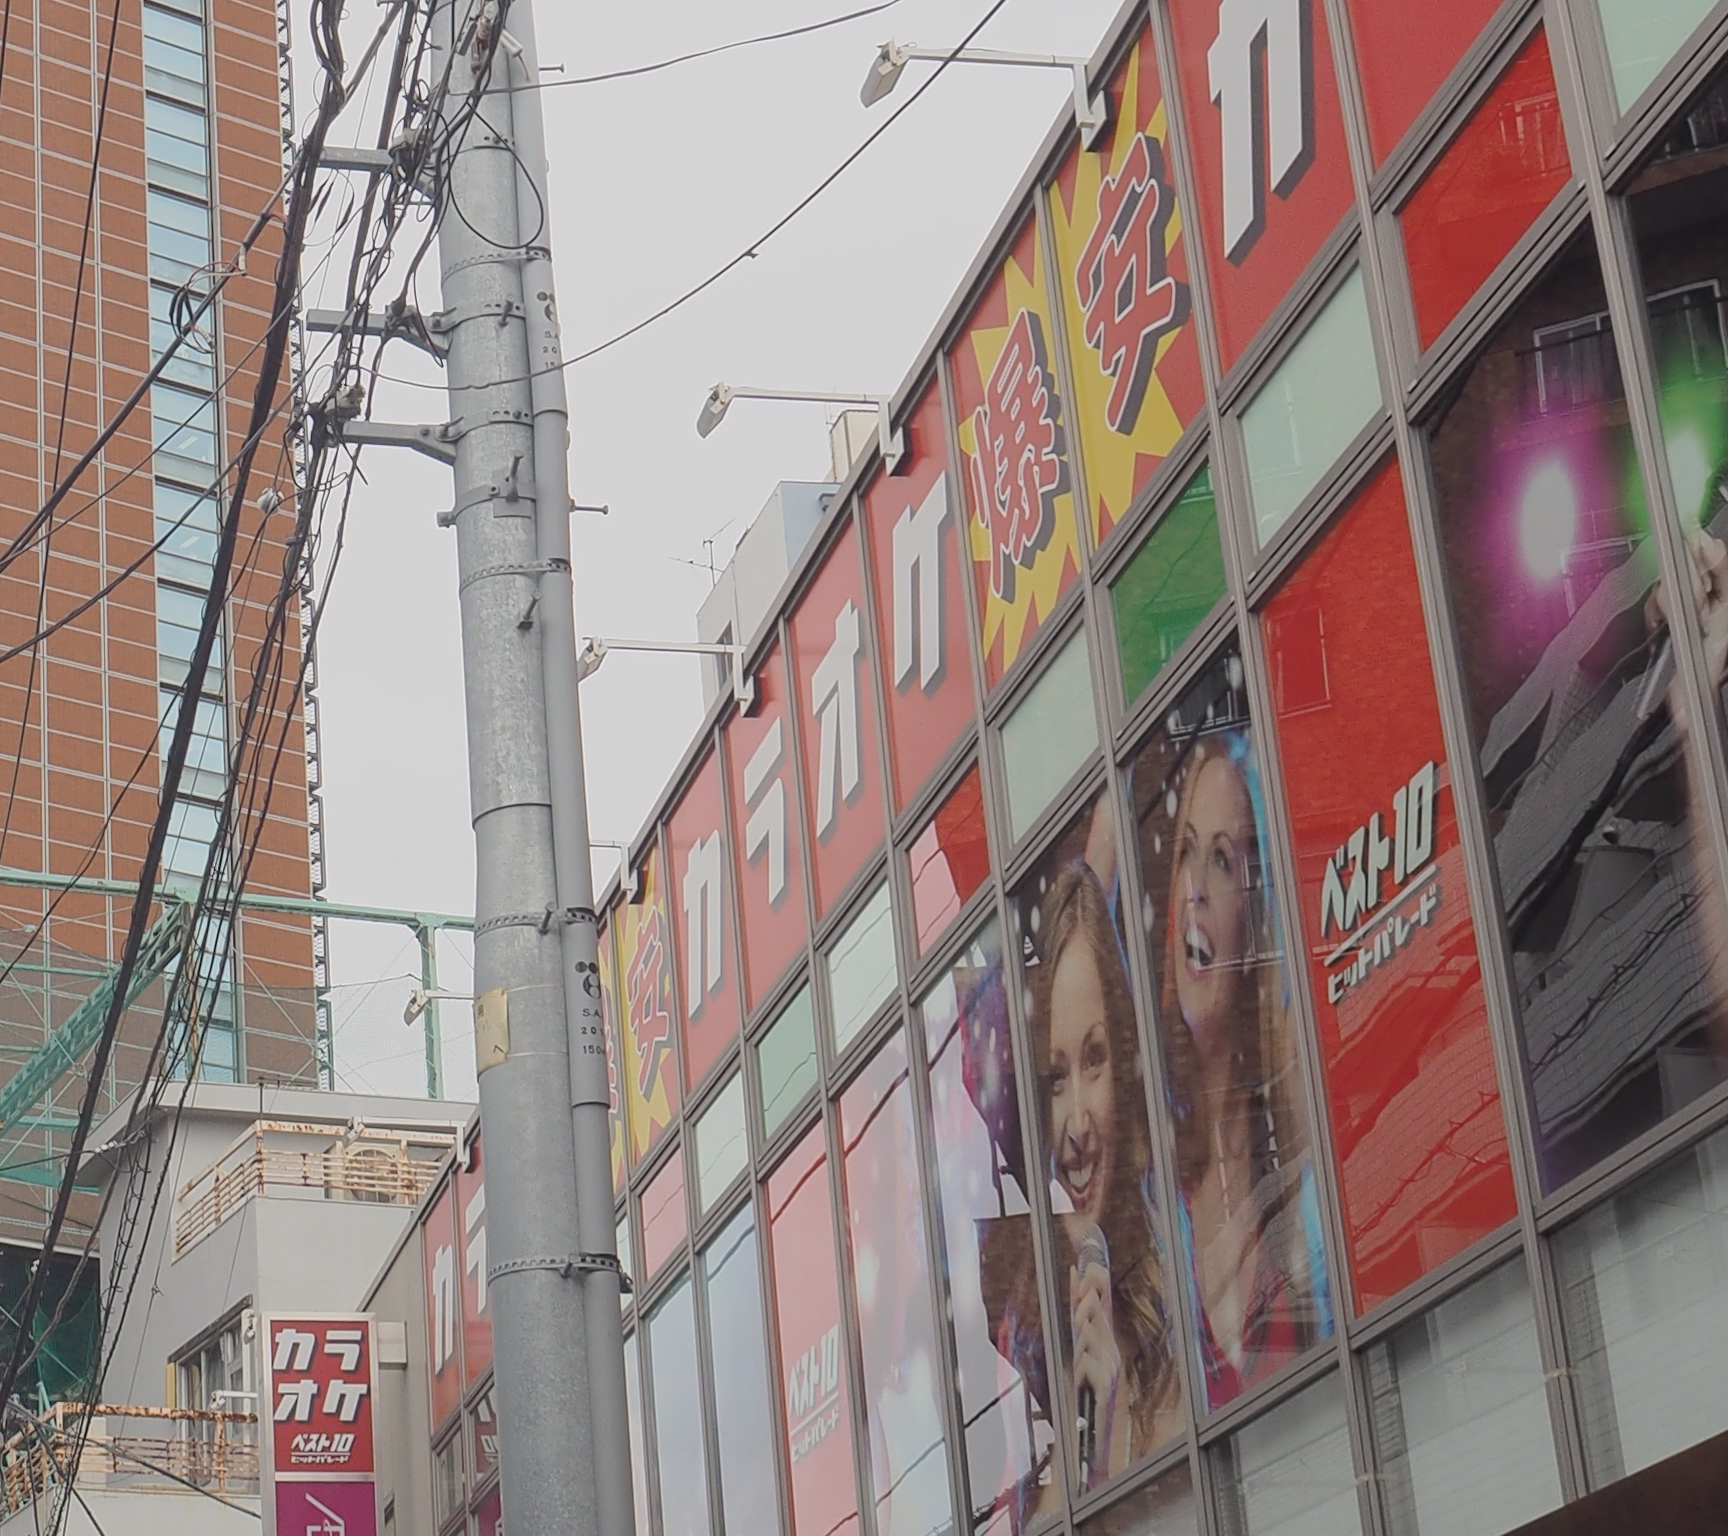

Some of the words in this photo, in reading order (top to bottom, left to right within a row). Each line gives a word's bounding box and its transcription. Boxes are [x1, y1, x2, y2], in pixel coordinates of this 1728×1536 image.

[683, 470, 955, 1020] カラオケ
[970, 131, 1177, 599] 爆安
[1321, 760, 1435, 937] ベスト10
[1328, 883, 1438, 1004] ヒットパレード
[788, 1323, 839, 1418] ベスト10
[290, 1433, 355, 1452] ベスト10
